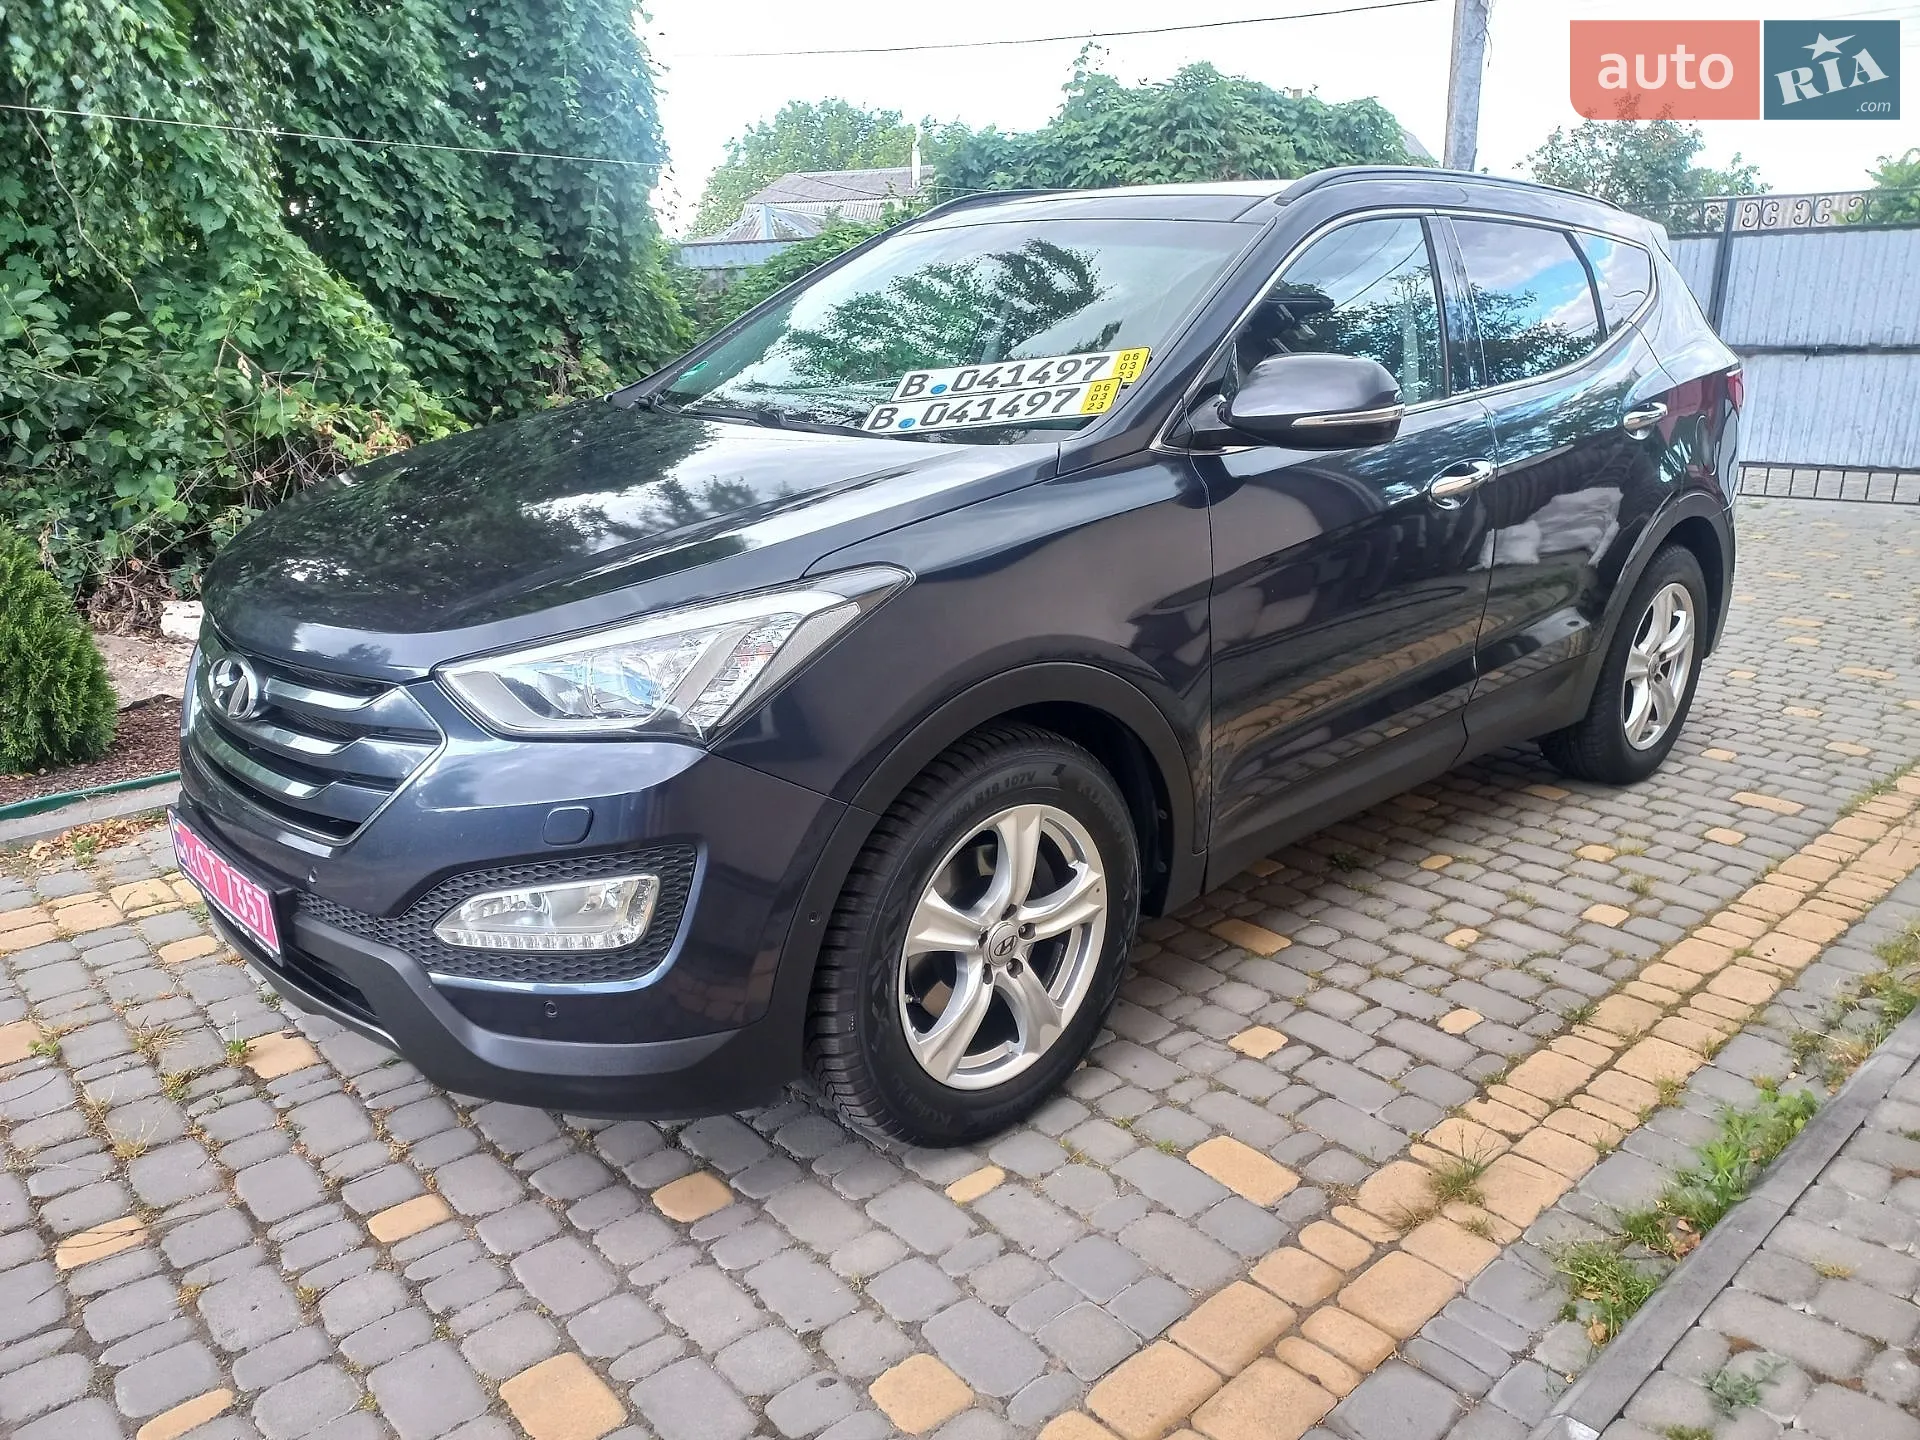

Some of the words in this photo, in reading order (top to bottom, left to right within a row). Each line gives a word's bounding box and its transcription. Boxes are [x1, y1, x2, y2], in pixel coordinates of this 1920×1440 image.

[899, 374, 929, 397] B
[951, 355, 1110, 392] 041497
[1120, 362, 1137, 371] 03
[867, 407, 898, 430] B
[920, 387, 1080, 426] 041497
[1086, 402, 1104, 411] 23
[1090, 393, 1107, 401] 03
[220, 866, 268, 936] 7357
